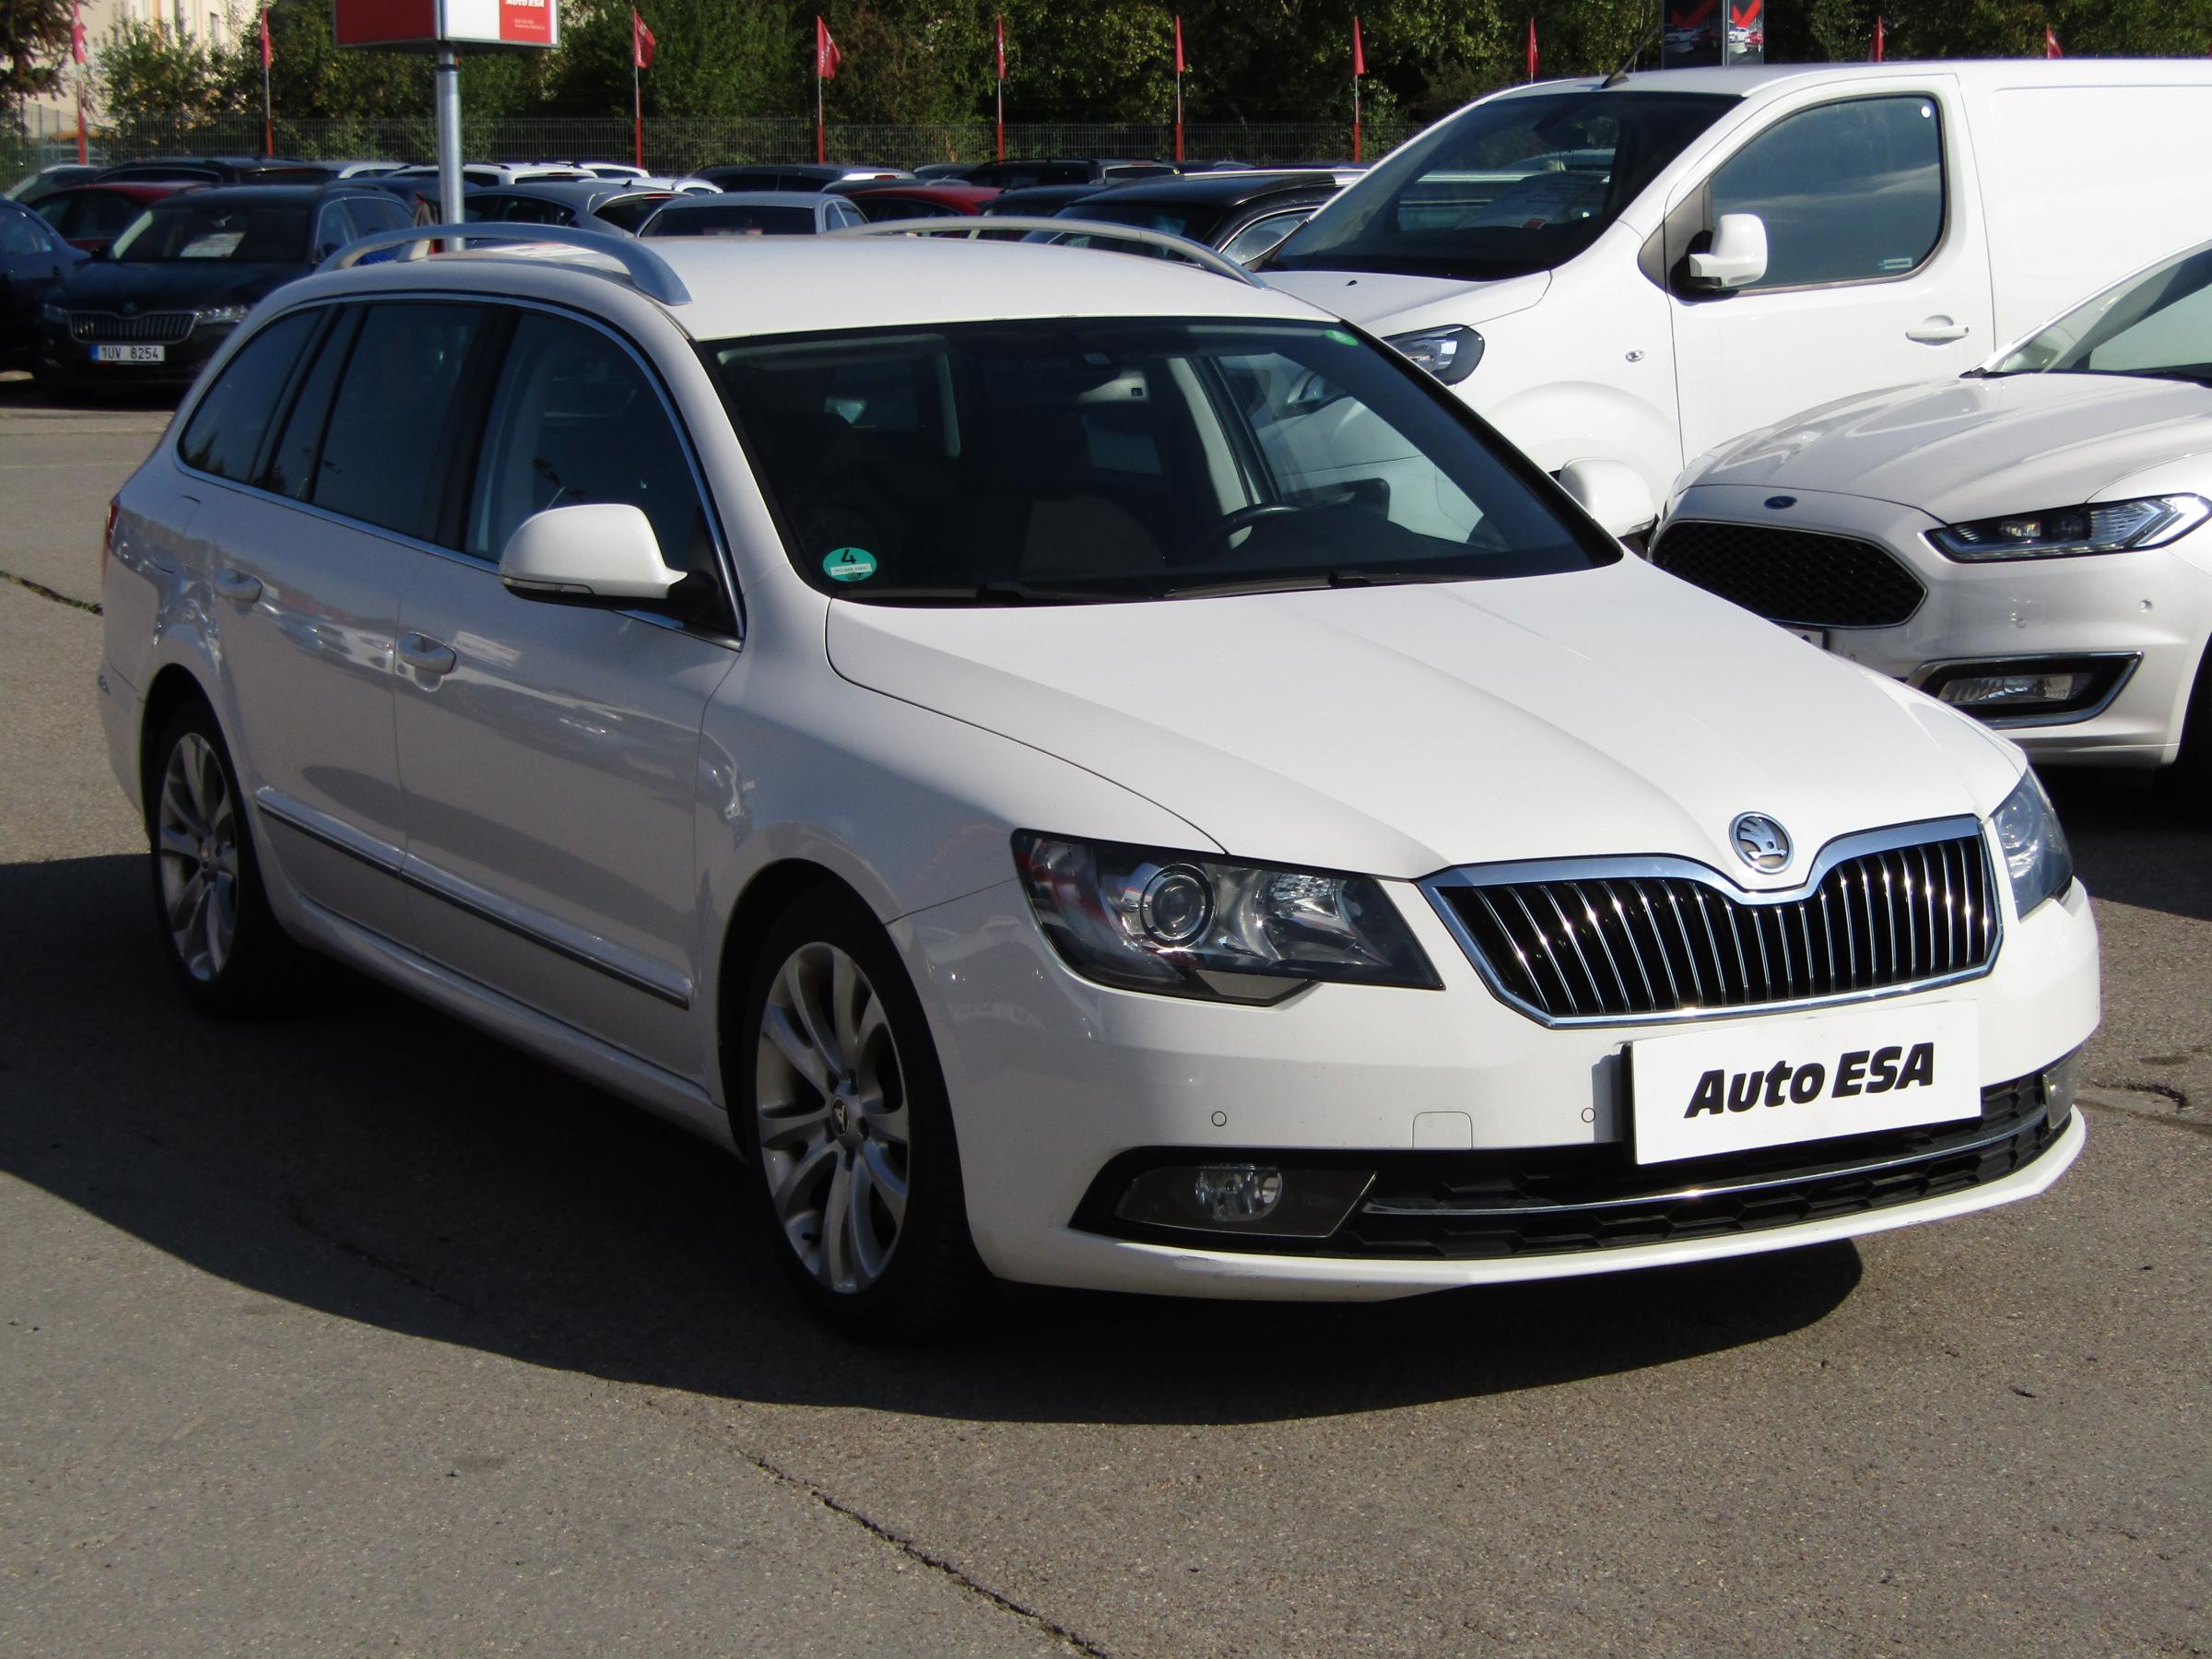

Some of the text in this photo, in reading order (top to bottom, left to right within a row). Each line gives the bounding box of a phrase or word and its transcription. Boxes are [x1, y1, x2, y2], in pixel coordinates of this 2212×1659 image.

[101, 346, 159, 359] 1UV 8254
[841, 548, 856, 564] 4
[1683, 1042, 1935, 1119] Auto ESA
